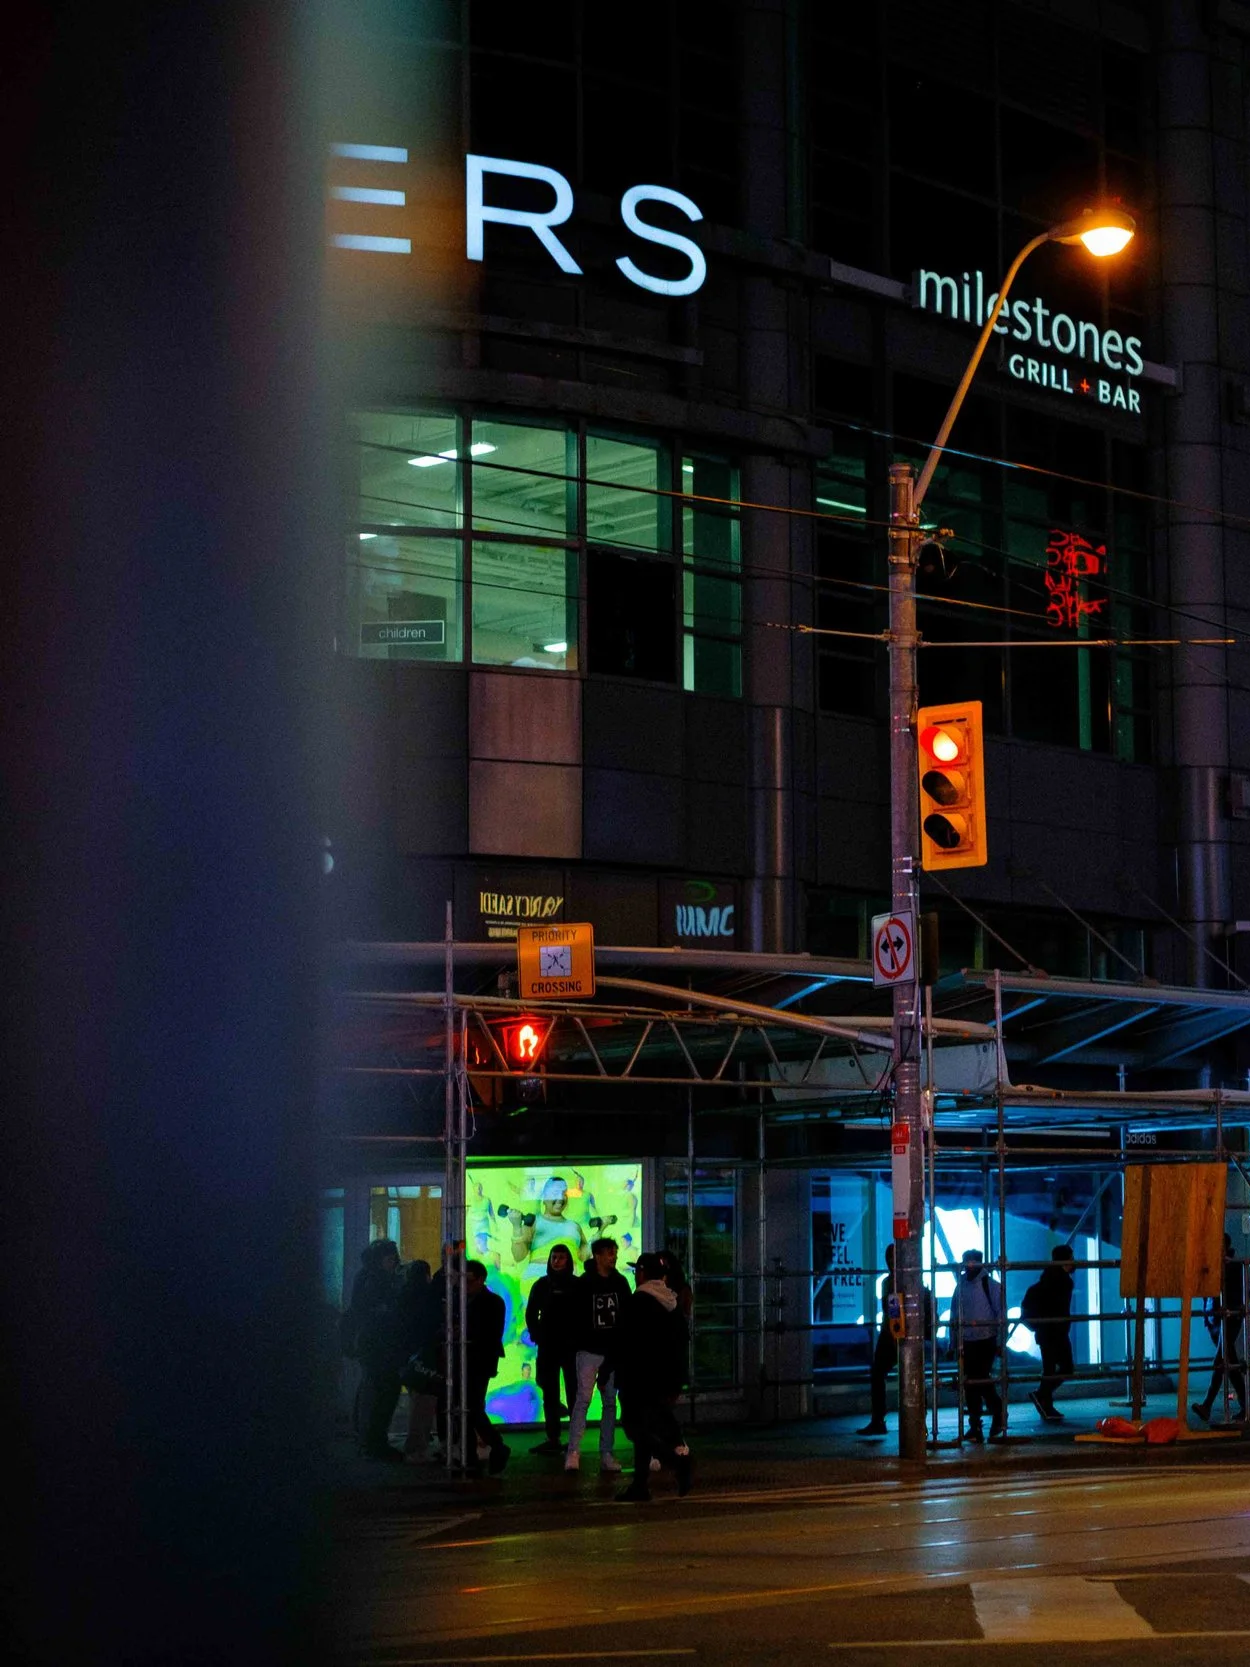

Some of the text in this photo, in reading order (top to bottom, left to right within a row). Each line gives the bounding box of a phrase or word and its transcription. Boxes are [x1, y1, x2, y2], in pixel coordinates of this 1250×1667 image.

[918, 268, 1144, 376] milestones
[1008, 353, 1074, 394] GRILL
[1097, 379, 1141, 414] BAR
[379, 627, 426, 638] children
[532, 929, 578, 942] PRIORITY
[531, 980, 582, 994] CROSSING
[1125, 1132, 1157, 1145] adidas
